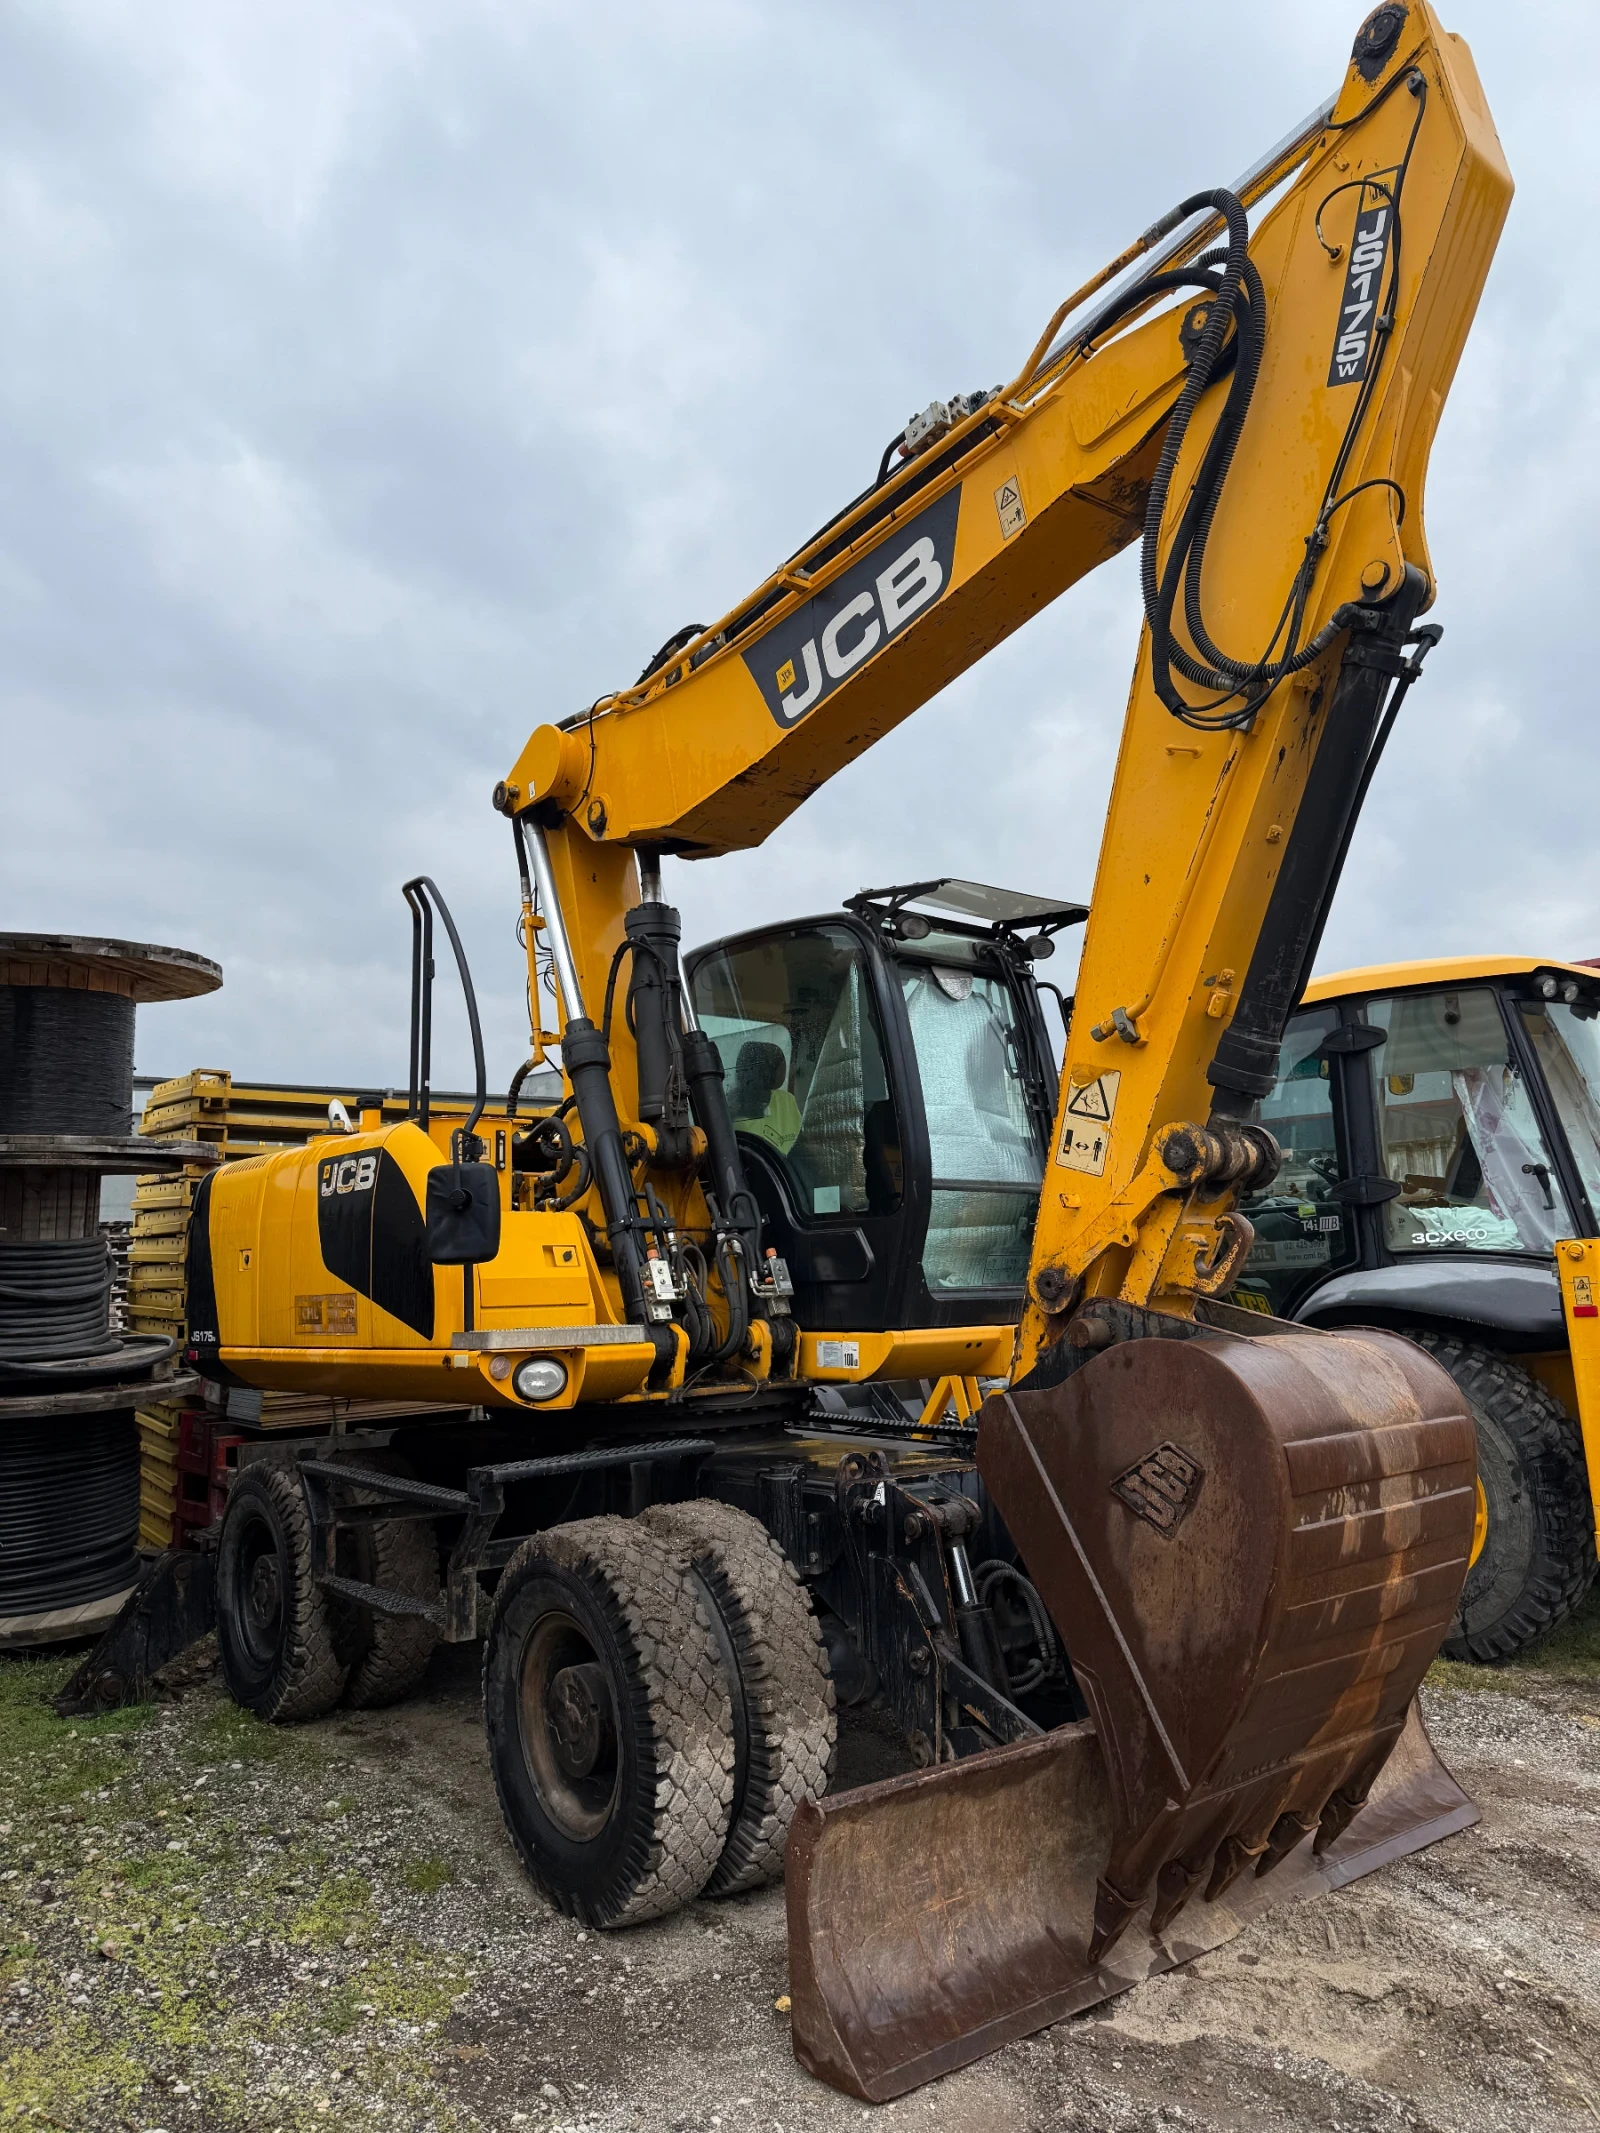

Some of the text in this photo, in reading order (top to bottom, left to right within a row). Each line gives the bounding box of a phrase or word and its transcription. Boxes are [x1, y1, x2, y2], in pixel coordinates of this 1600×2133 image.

[781, 537, 943, 719] JCB
[320, 1155, 377, 1197] JCB
[1300, 1219, 1319, 1231] T4i
[1122, 1450, 1195, 1528] JCB
